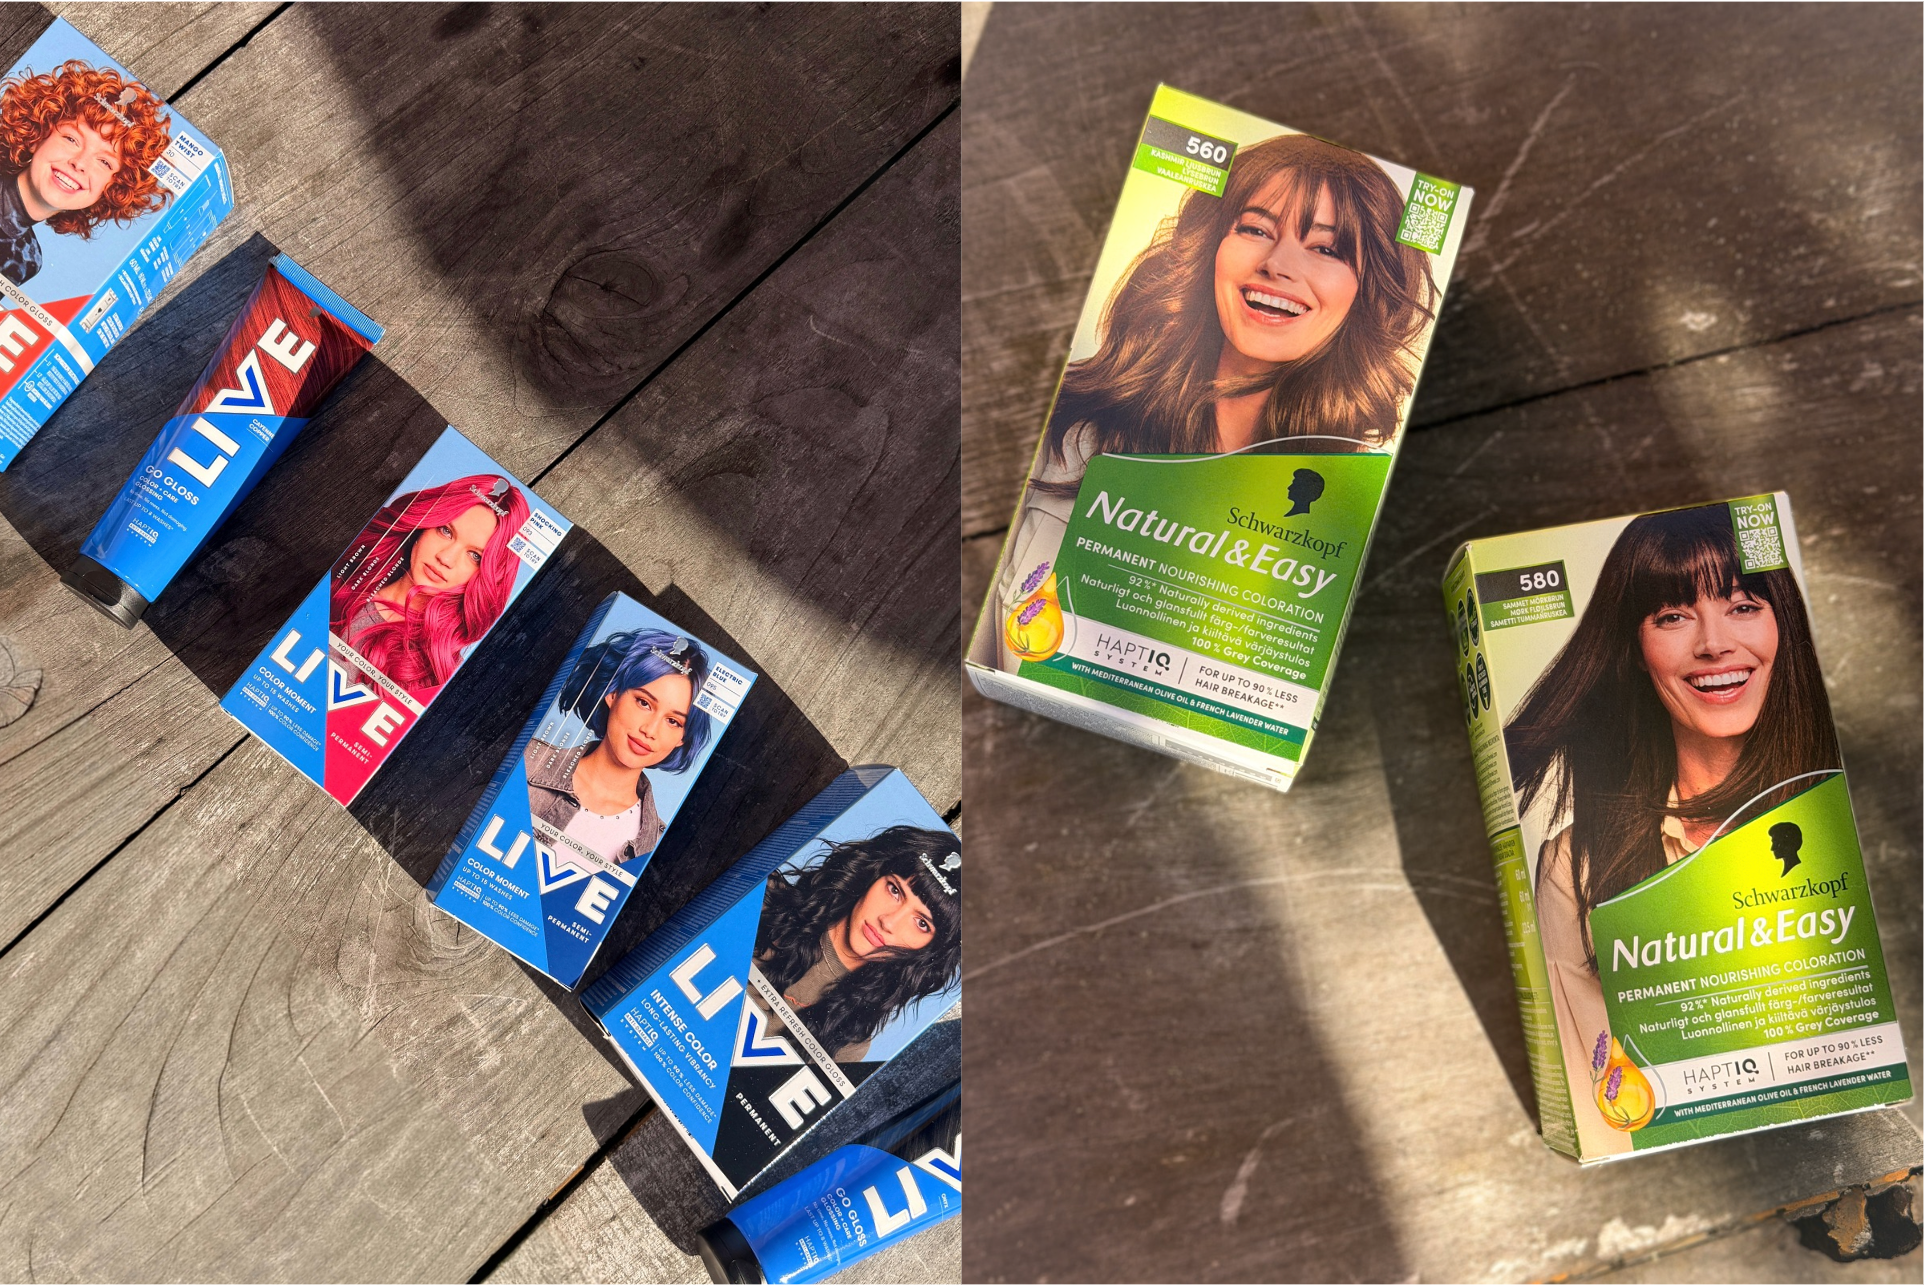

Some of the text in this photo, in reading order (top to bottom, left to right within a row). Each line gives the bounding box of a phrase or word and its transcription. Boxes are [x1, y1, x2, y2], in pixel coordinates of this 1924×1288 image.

[174, 140, 194, 158] TWIST
[179, 135, 203, 156] MANGO
[1150, 149, 1221, 178] KASHMIR LJUSBRUN
[1184, 136, 1228, 164] 560
[1155, 166, 1217, 192] VAALEANRUSKEA
[1181, 167, 1219, 185] LYSEBRUN
[1416, 179, 1454, 199] TRY-ON
[1412, 189, 1452, 212] NOW
[4, 285, 52, 326] COLOR GLOSS
[167, 317, 317, 489] LIVE
[135, 480, 163, 500] GLOSSING
[139, 475, 158, 489] COLOR
[162, 490, 178, 503] CARE
[145, 464, 163, 479] GO
[163, 475, 199, 505] GLOSS
[529, 517, 543, 529] PINK
[533, 512, 562, 536] SHOCKING
[1734, 501, 1772, 516] TRY-ON
[1736, 511, 1775, 529] NOW
[1226, 507, 1347, 559] Schwarzkopf
[1075, 537, 1324, 624] PERMANENT NOURISHING COLORATION
[1519, 569, 1560, 592] 580
[1080, 573, 1315, 656] Naturligt och glansfullt färg-/farveresultat
[1158, 583, 1319, 644] Naturally derived ingredients
[1502, 598, 1529, 610] SAMMET
[1115, 597, 1311, 669] Luonnollinen ja kiiltävä värjäystulos
[1490, 617, 1517, 628] SAMETTI
[1093, 650, 1162, 676] SYSTEM
[1096, 633, 1173, 671] HAPTIQ
[1222, 645, 1307, 681] Grey Coverage
[245, 681, 270, 702] HAPTIQ
[258, 666, 285, 689] COLOR
[284, 686, 315, 714] MOMENT
[268, 627, 406, 748] LIVE
[336, 642, 412, 705] YOUR COLOR, YOUR STYLE
[712, 671, 726, 682] BLUE
[715, 666, 742, 685] ELECTRIC
[1194, 678, 1219, 693] HAIR
[1198, 666, 1298, 703] FOR UP TO LESS
[252, 674, 261, 682] UP
[260, 680, 269, 689] TO
[276, 693, 299, 713] WASHES
[1070, 662, 1289, 736] WITH MEDITERRANEAN OLIVE OIL & FRENCH LAVENDER WATER
[330, 732, 368, 765] PERMANENT
[353, 741, 373, 759] SEMI-
[540, 823, 623, 877] YOUR COLOR, YOUR STYLE
[456, 874, 482, 894] HAPTIQ
[461, 866, 471, 874] UP
[471, 872, 480, 880] TO
[488, 882, 512, 900] WASHES
[466, 857, 495, 878] COLOR
[494, 874, 529, 899] MOMENT
[474, 813, 620, 925] LIVE
[918, 852, 957, 895] Schwarzkopf
[1732, 872, 1849, 908] Schwarzkopf
[547, 915, 589, 943] PERMANENT
[571, 921, 592, 937] SEMI-
[1617, 947, 1866, 1003] PERMANENT NOURISHING COLORATION
[1710, 968, 1871, 1009] Naturally derived ingredients
[629, 1006, 659, 1042] HAPTIQ
[1639, 982, 1874, 1036] Naturligt och glansfullt färg-/farveresultat
[1680, 995, 1877, 1040] Luonnollinen ja kiiltävä värjäystulos
[1795, 1008, 1880, 1034] Grey Coverage
[640, 998, 686, 1053] LONG-LASTING
[683, 1052, 715, 1090] VIBRANCY
[650, 988, 687, 1032] INTENSE
[683, 1030, 717, 1070] COLOR
[668, 942, 833, 1131] LIVE
[760, 984, 845, 1087] EXTRA REFRESH COLOR GLOSS
[1784, 1035, 1883, 1060] FOR UP TO LESS
[665, 1055, 696, 1092] TO LESS
[665, 1067, 683, 1088] COLOR
[1683, 1058, 1759, 1086] HAPTIQ
[1686, 1076, 1755, 1094] SYSTEM
[1787, 1062, 1811, 1074] HAIR
[1674, 1069, 1891, 1117] WITH MEDITERRANEAN OLIVE OIL & FRENCH LAVENDER WATER
[735, 1092, 781, 1147] PERMANENT
[862, 1132, 962, 1239] LIV
[820, 1196, 841, 1230] GLOSSING
[826, 1193, 851, 1239] COLOR CARE
[835, 1186, 867, 1246] GO GLOSS
